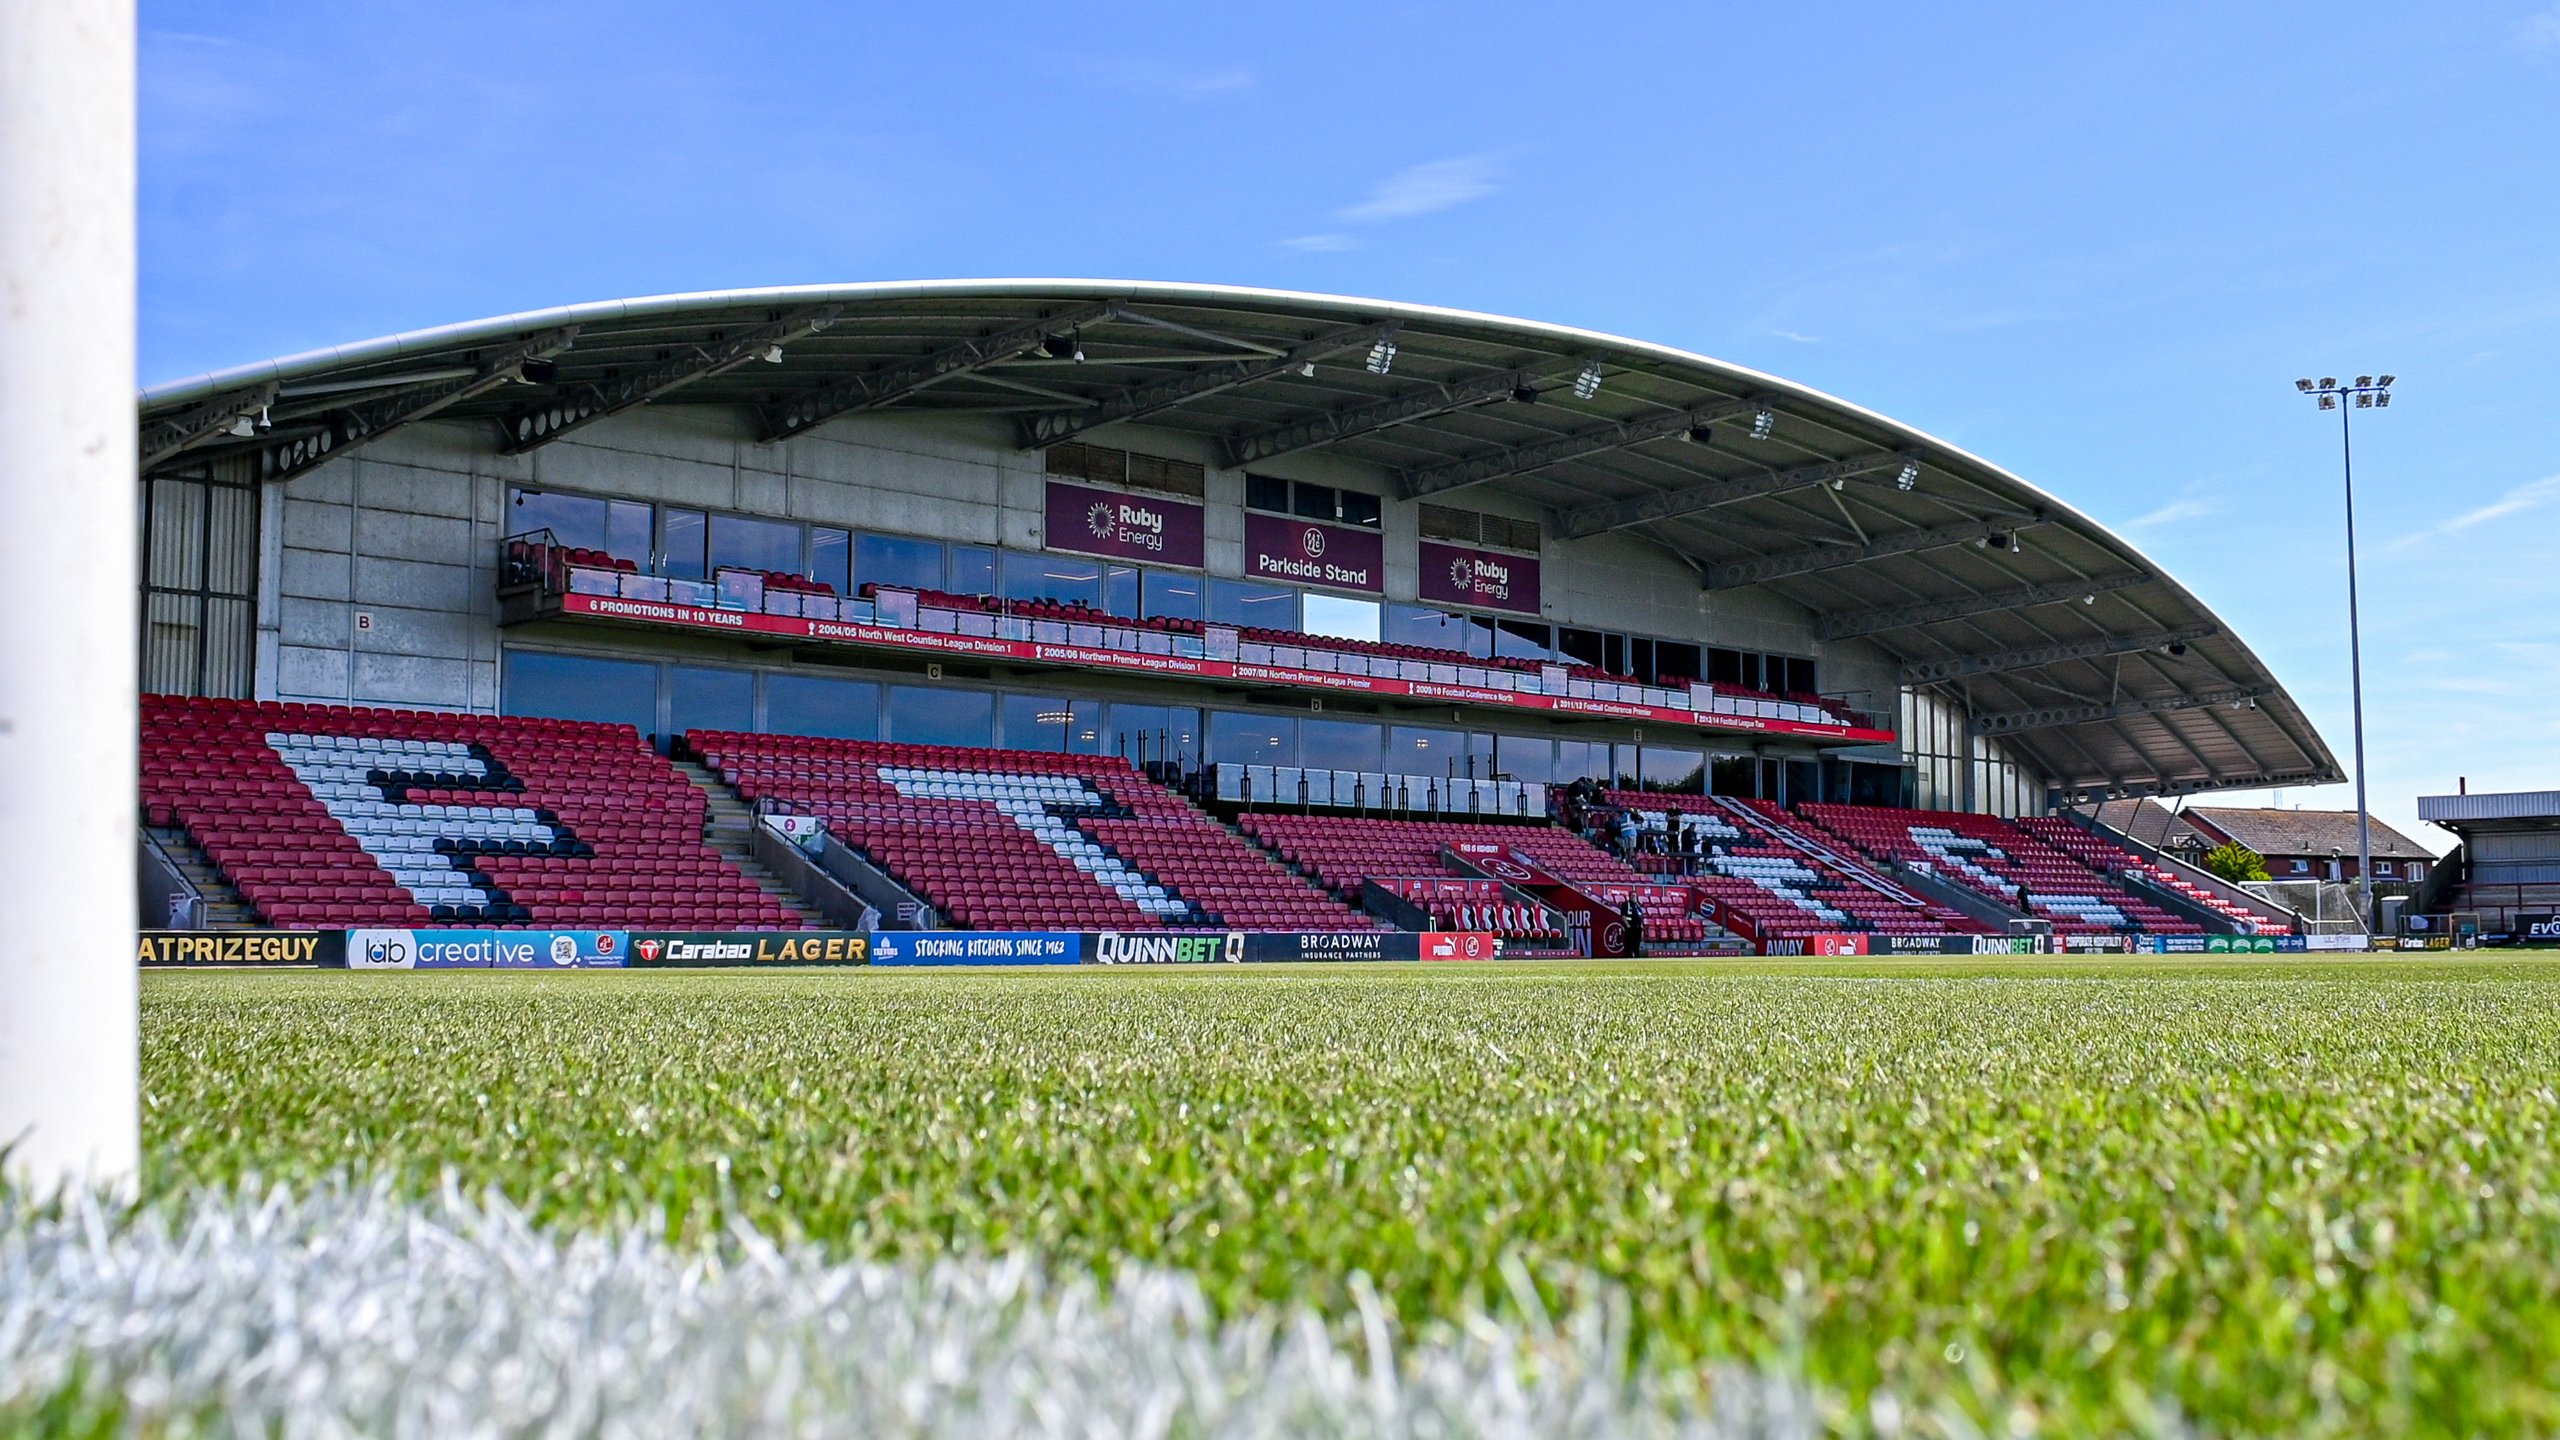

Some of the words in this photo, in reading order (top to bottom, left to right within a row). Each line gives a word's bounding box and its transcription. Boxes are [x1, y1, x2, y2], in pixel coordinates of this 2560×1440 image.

[1119, 504, 1162, 533] Ruby
[1119, 528, 1162, 551] Energy
[1260, 553, 1321, 578] Parkside
[1325, 564, 1367, 584] Stand
[1475, 560, 1507, 584] Ruby
[1474, 579, 1508, 600] Energy
[360, 616, 369, 628] B
[590, 600, 597, 611] 6
[600, 600, 674, 618] PROMOTIONS
[677, 610, 689, 621] IN
[692, 611, 706, 622] 10
[708, 612, 743, 625] YEARS
[818, 625, 856, 637] 2004/05
[859, 630, 882, 641] North
[883, 631, 905, 643] West
[906, 633, 942, 646] Counties
[944, 637, 973, 650] League
[975, 639, 1005, 652] Division
[1007, 644, 1012, 653] 1
[1045, 648, 1078, 660] 2005/06
[1080, 651, 1111, 662] Northern
[1113, 654, 1140, 665] Premier
[1141, 656, 1167, 669] League
[1168, 658, 1196, 671] Division
[931, 667, 938, 678] C
[1238, 668, 1267, 678] 2007/08
[1269, 670, 1297, 680] Northern
[1298, 673, 1323, 683] Premier
[1323, 675, 1346, 687] League
[1347, 677, 1371, 688] Premier
[1442, 688, 1465, 698] Football
[1465, 689, 1497, 701] Conference
[1498, 694, 1514, 702] North
[1313, 700, 1319, 710] D
[1583, 702, 1604, 712] Football
[1604, 703, 1632, 714] Conference
[1633, 707, 1652, 716] Premier
[1635, 730, 1641, 740] E
[787, 821, 793, 830] 2
[365, 938, 405, 963] lab
[418, 939, 535, 963] creative
[666, 939, 752, 960] Carabao
[756, 938, 866, 961] LAGER
[915, 939, 964, 958] STOCKING
[968, 939, 1013, 958] KITCHENS
[1016, 939, 1043, 957] SINCE
[1096, 932, 1221, 965] QUINNBET
[1301, 935, 1381, 949] BROADWAY
[1766, 939, 1804, 956] AWAY
[1891, 937, 1941, 948] BROADWAY
[1972, 934, 2033, 955] QUINNBET
[2425, 937, 2450, 948] LAGER
[1301, 951, 1342, 960] INSURANCE
[1345, 951, 1381, 959] PARTNERS
